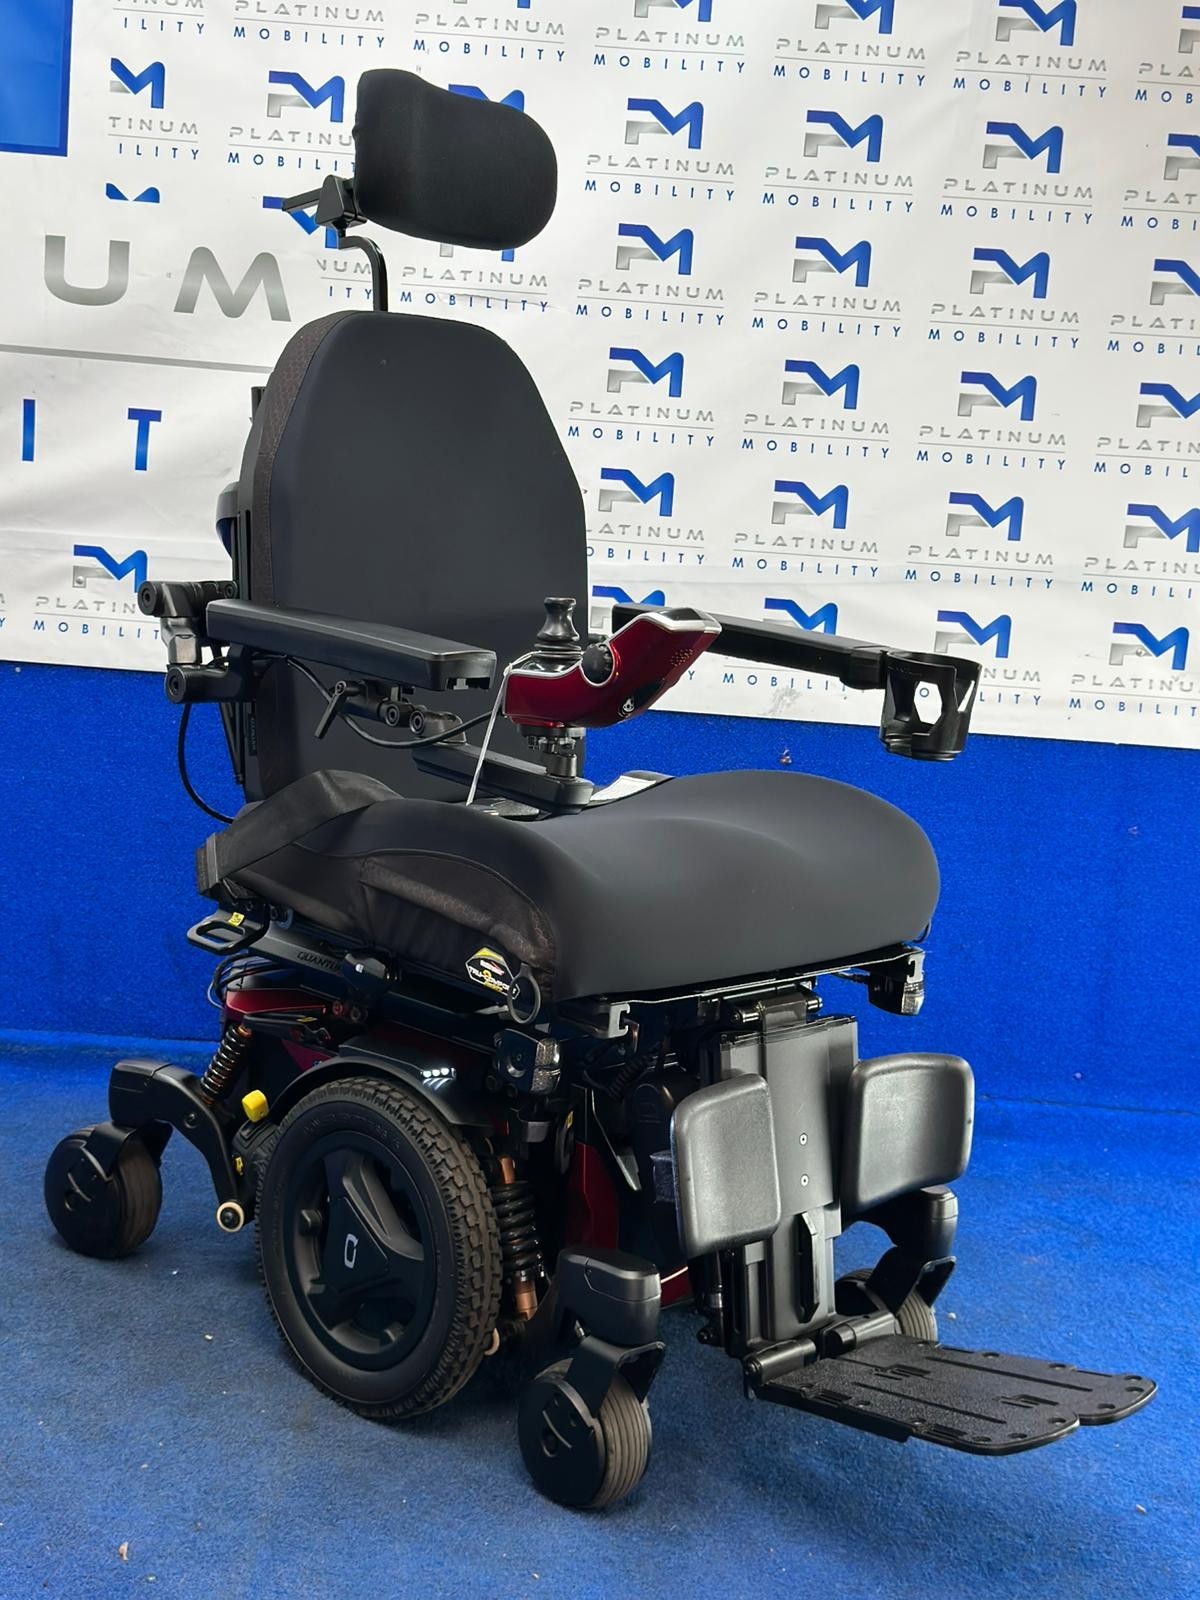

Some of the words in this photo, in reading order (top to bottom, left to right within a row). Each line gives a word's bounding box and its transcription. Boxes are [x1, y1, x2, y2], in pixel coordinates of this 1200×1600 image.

[235, 0, 384, 22] PLATINUM
[415, 13, 564, 36] PLATINUM
[233, 26, 385, 49] MOBILITY
[595, 26, 744, 47] PLATINUM
[413, 39, 565, 62] MOBILITY
[775, 38, 925, 60] PLATINUM
[593, 54, 745, 74] MOBILITY
[956, 51, 1107, 72] PLATINUM
[1138, 62, 1200, 78] PLA
[773, 64, 926, 87] MOBILITY
[953, 77, 1107, 98] MOBILITY
[229, 126, 352, 146] PLATINU
[227, 152, 356, 173] MOBILI
[587, 154, 734, 176] PLATINUM
[765, 166, 913, 187] PLATINUM
[585, 180, 735, 201] MOBILITY
[944, 178, 1092, 199] PLATINUM
[762, 192, 913, 213] MOBILITY
[941, 204, 1093, 225] MOBILITY
[402, 266, 548, 287] PLATINUM
[578, 278, 724, 301] PLATINUM
[400, 291, 549, 312] MOBILITY
[754, 292, 901, 312] PLATINUM
[576, 304, 724, 325] MOBILITY
[931, 303, 1079, 323] PLATINUM
[751, 317, 901, 338] MOBILITY
[928, 329, 1079, 349] MOBILITY
[569, 401, 714, 422] PLATINUM
[744, 413, 889, 435] PLATINUM
[567, 426, 714, 447] MOBILITY
[919, 425, 1066, 446] PLATINUM
[742, 438, 889, 459] MOBILITY
[917, 450, 1066, 470] MOBILITY
[587, 523, 704, 542] ATINUM
[734, 533, 879, 554] PLATINUM
[587, 547, 705, 565] OBILITY
[908, 545, 1053, 565] PLATINUM
[732, 557, 879, 578] MOBILITY
[905, 569, 1053, 589] MOBILITY
[36, 596, 136, 614] PLATIN
[33, 620, 159, 640] MOBILIT
[722, 673, 846, 692] MOBILI
[1071, 674, 1200, 693] PLATINU
